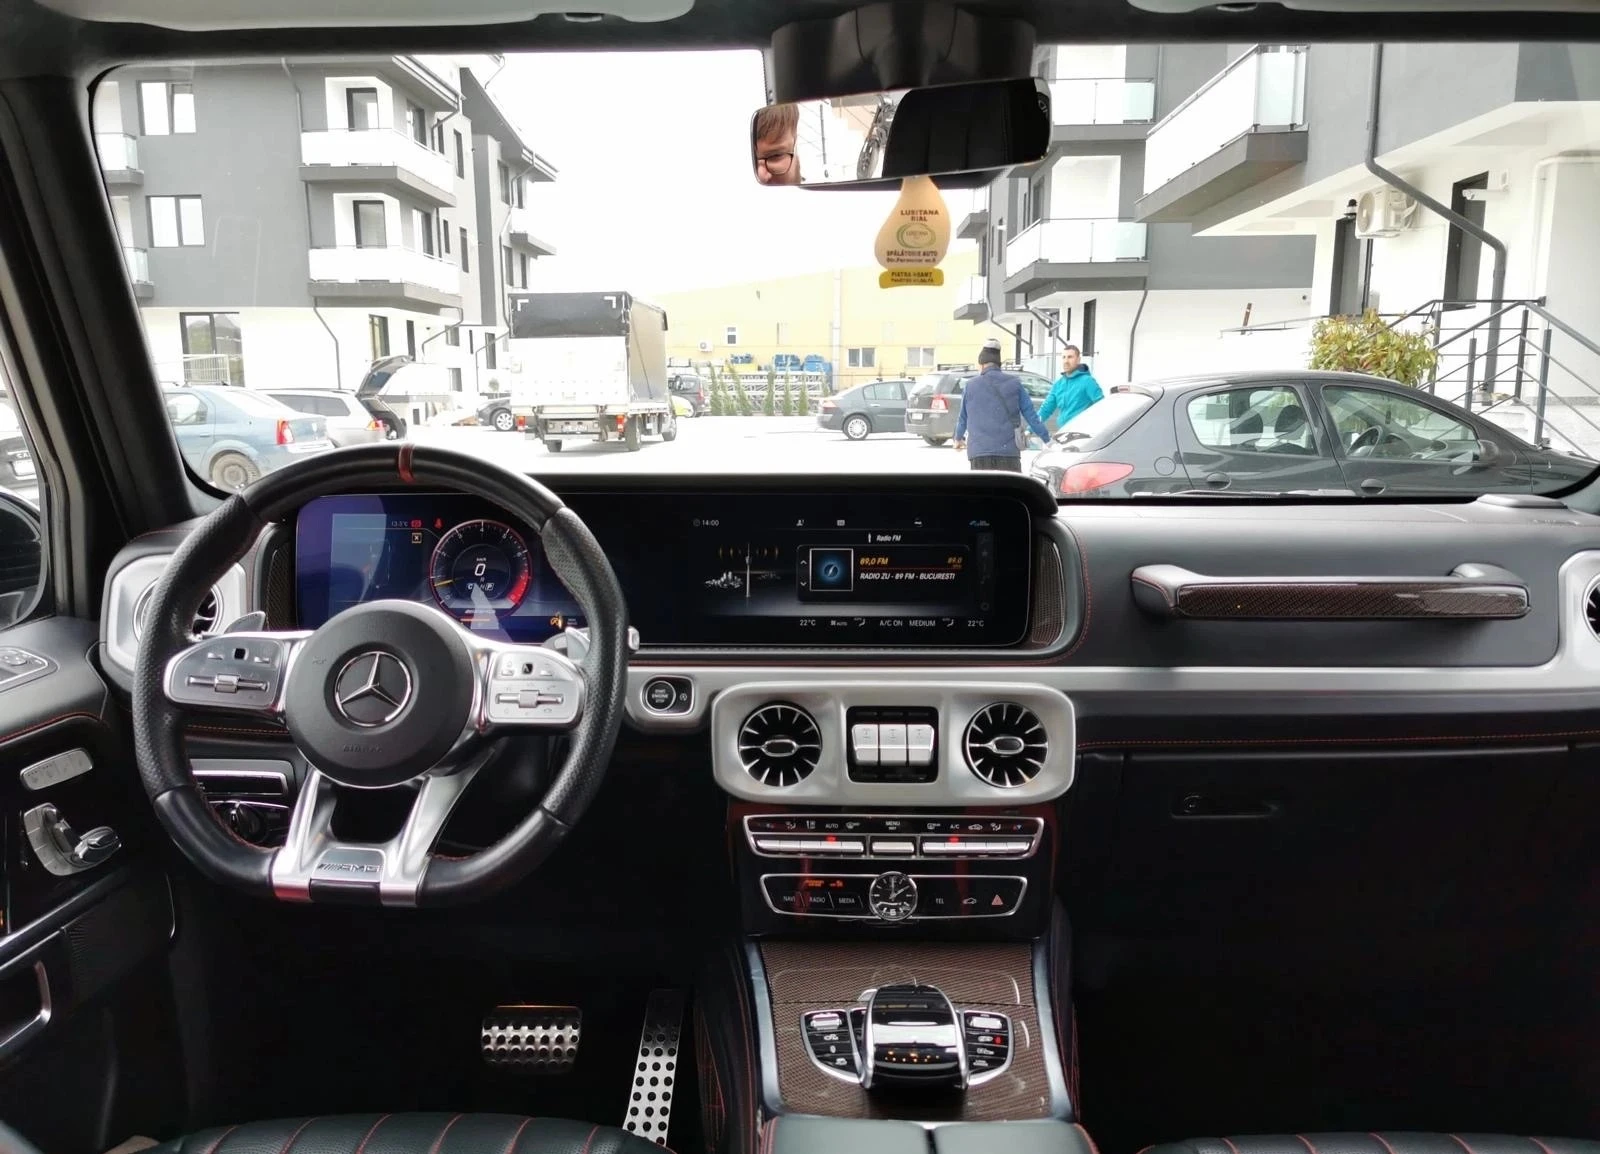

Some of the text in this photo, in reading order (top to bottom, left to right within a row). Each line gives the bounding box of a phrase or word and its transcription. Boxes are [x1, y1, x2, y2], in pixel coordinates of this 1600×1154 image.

[702, 519, 720, 527] 14:00
[876, 534, 902, 542] Radio FM
[876, 557, 889, 565] FM
[474, 563, 486, 576] 0
[859, 572, 881, 580] RADIO
[880, 572, 891, 580] ZU
[894, 572, 903, 580] 89
[904, 572, 915, 580] FM
[919, 572, 956, 580] BUCURESTI
[879, 619, 903, 627] A/C ON
[909, 619, 936, 627] MEDIUM
[967, 619, 984, 627] 22°C
[935, 897, 945, 905] TEL
